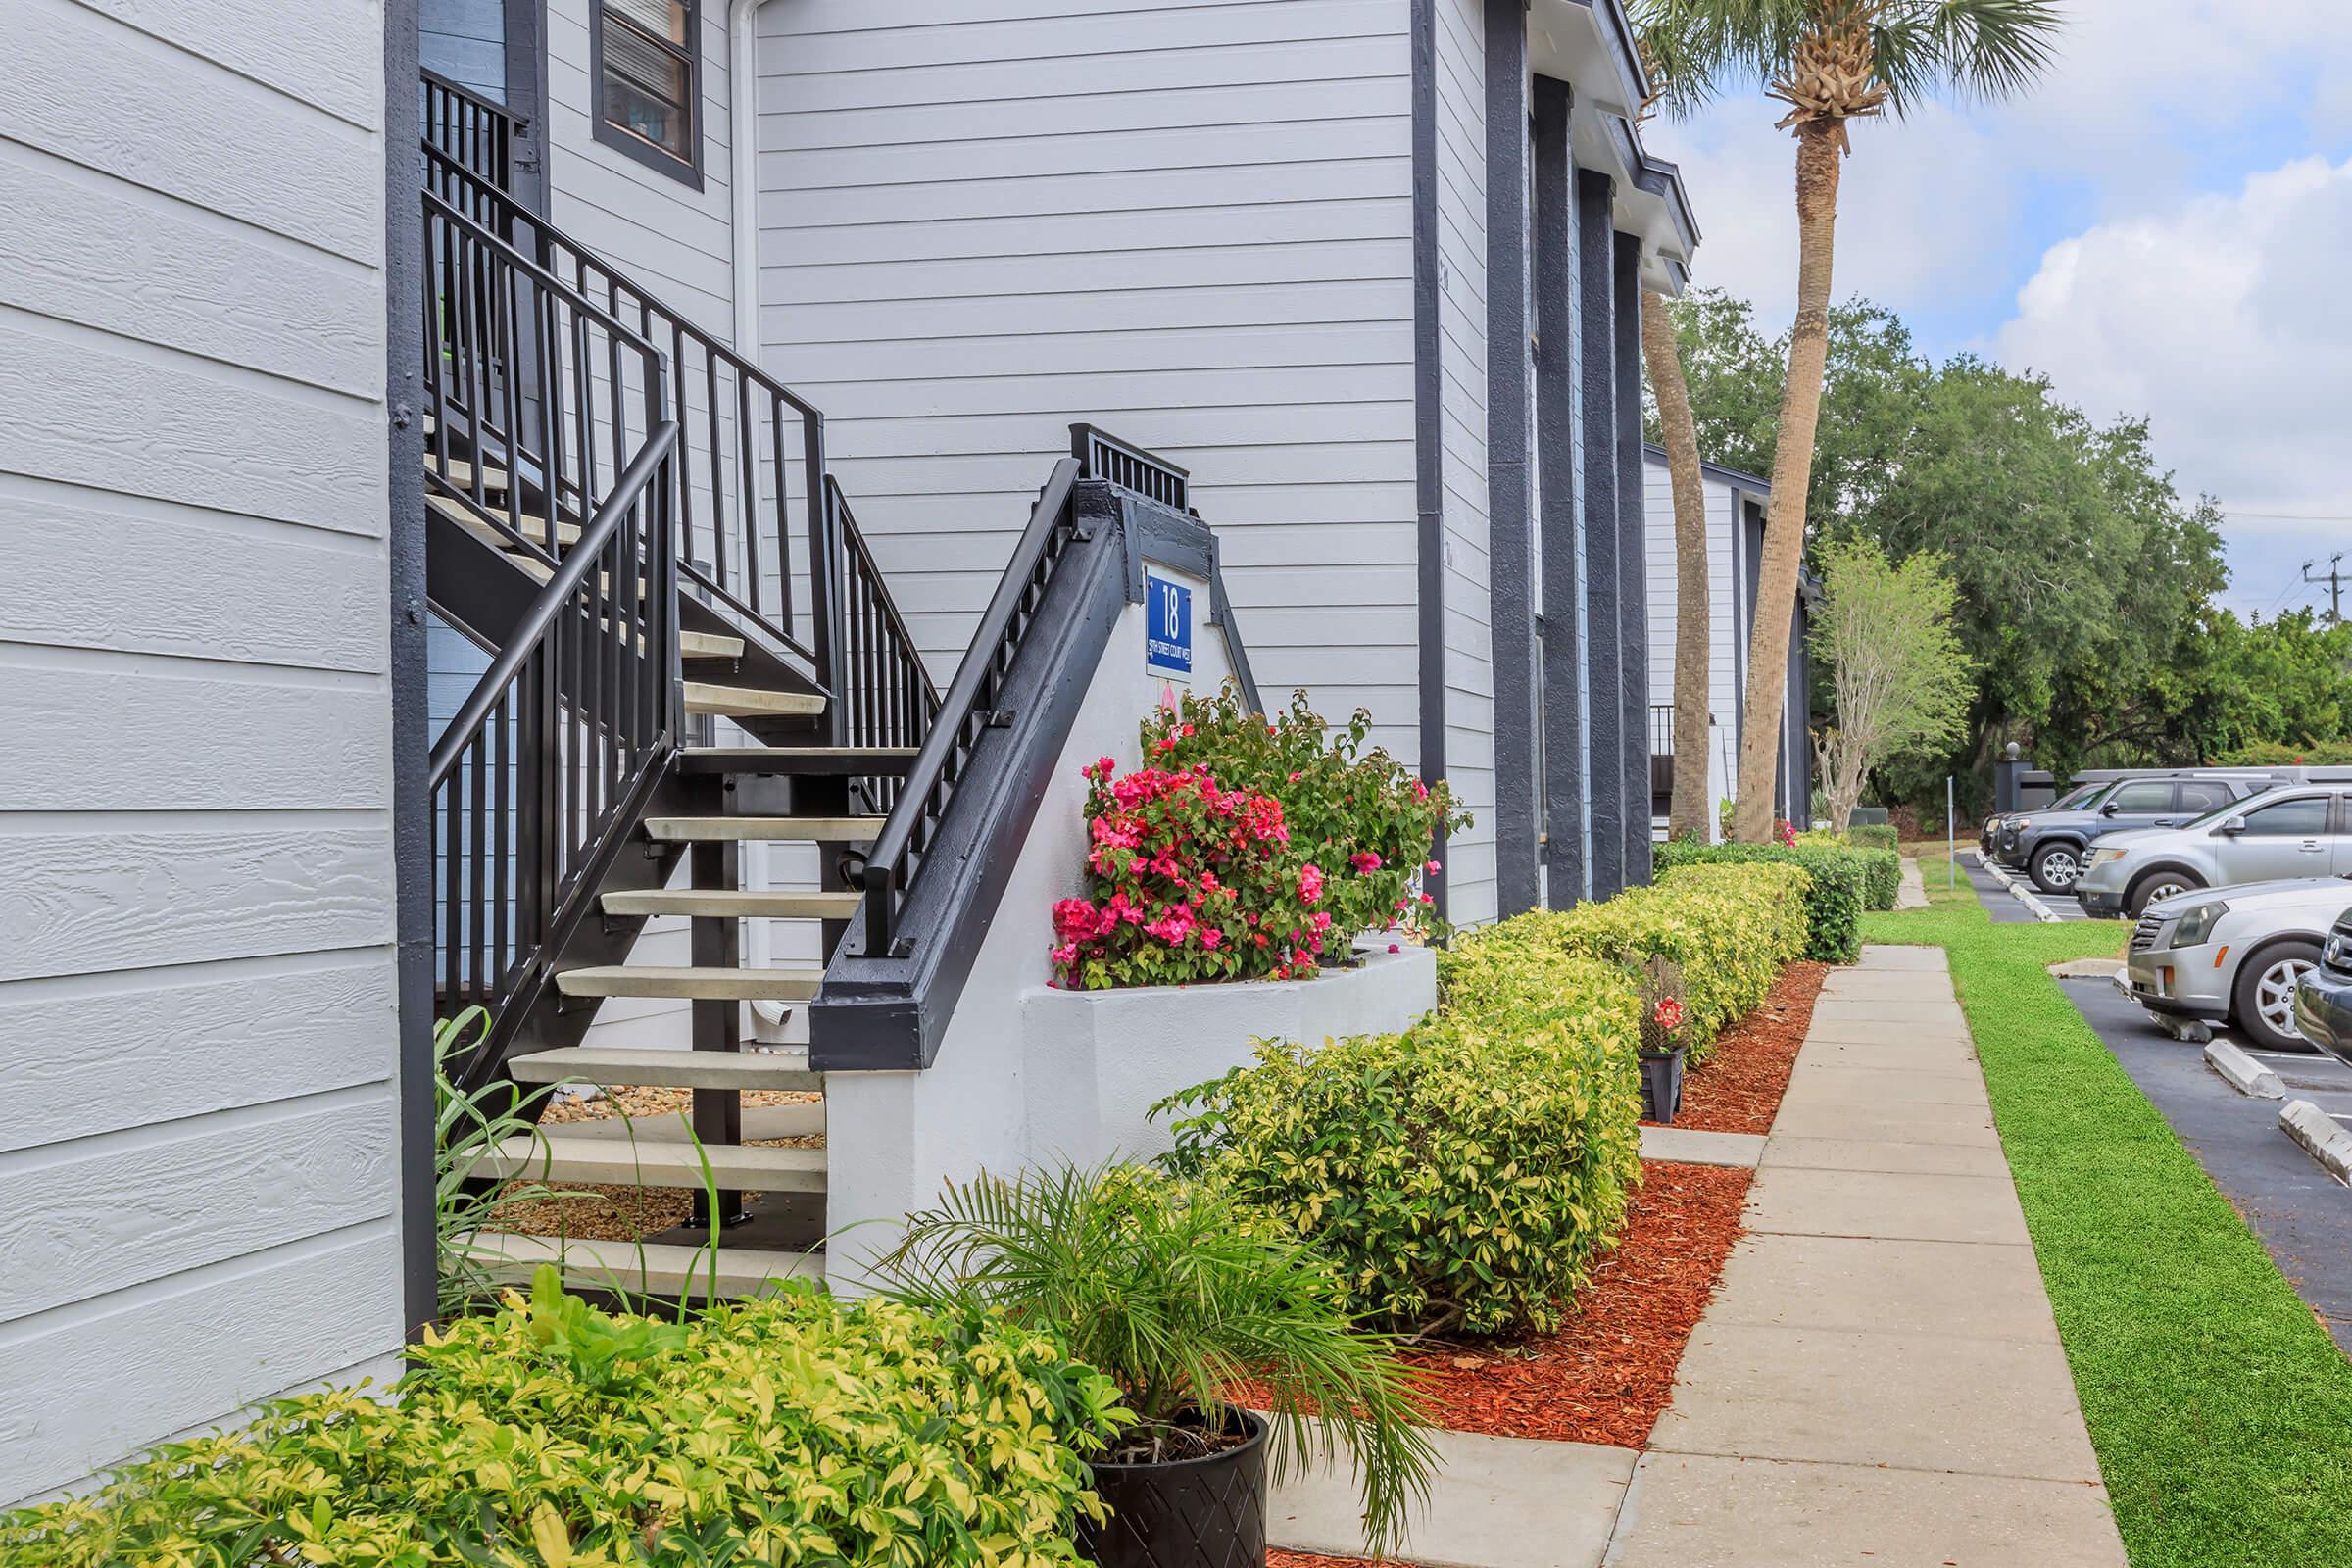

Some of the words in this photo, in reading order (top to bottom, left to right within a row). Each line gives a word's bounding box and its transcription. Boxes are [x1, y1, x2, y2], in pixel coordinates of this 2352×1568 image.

[1163, 585, 1179, 640] 18
[1158, 641, 1170, 655] STREET
[1170, 644, 1182, 659] COURT
[1182, 647, 1191, 661] WEST
